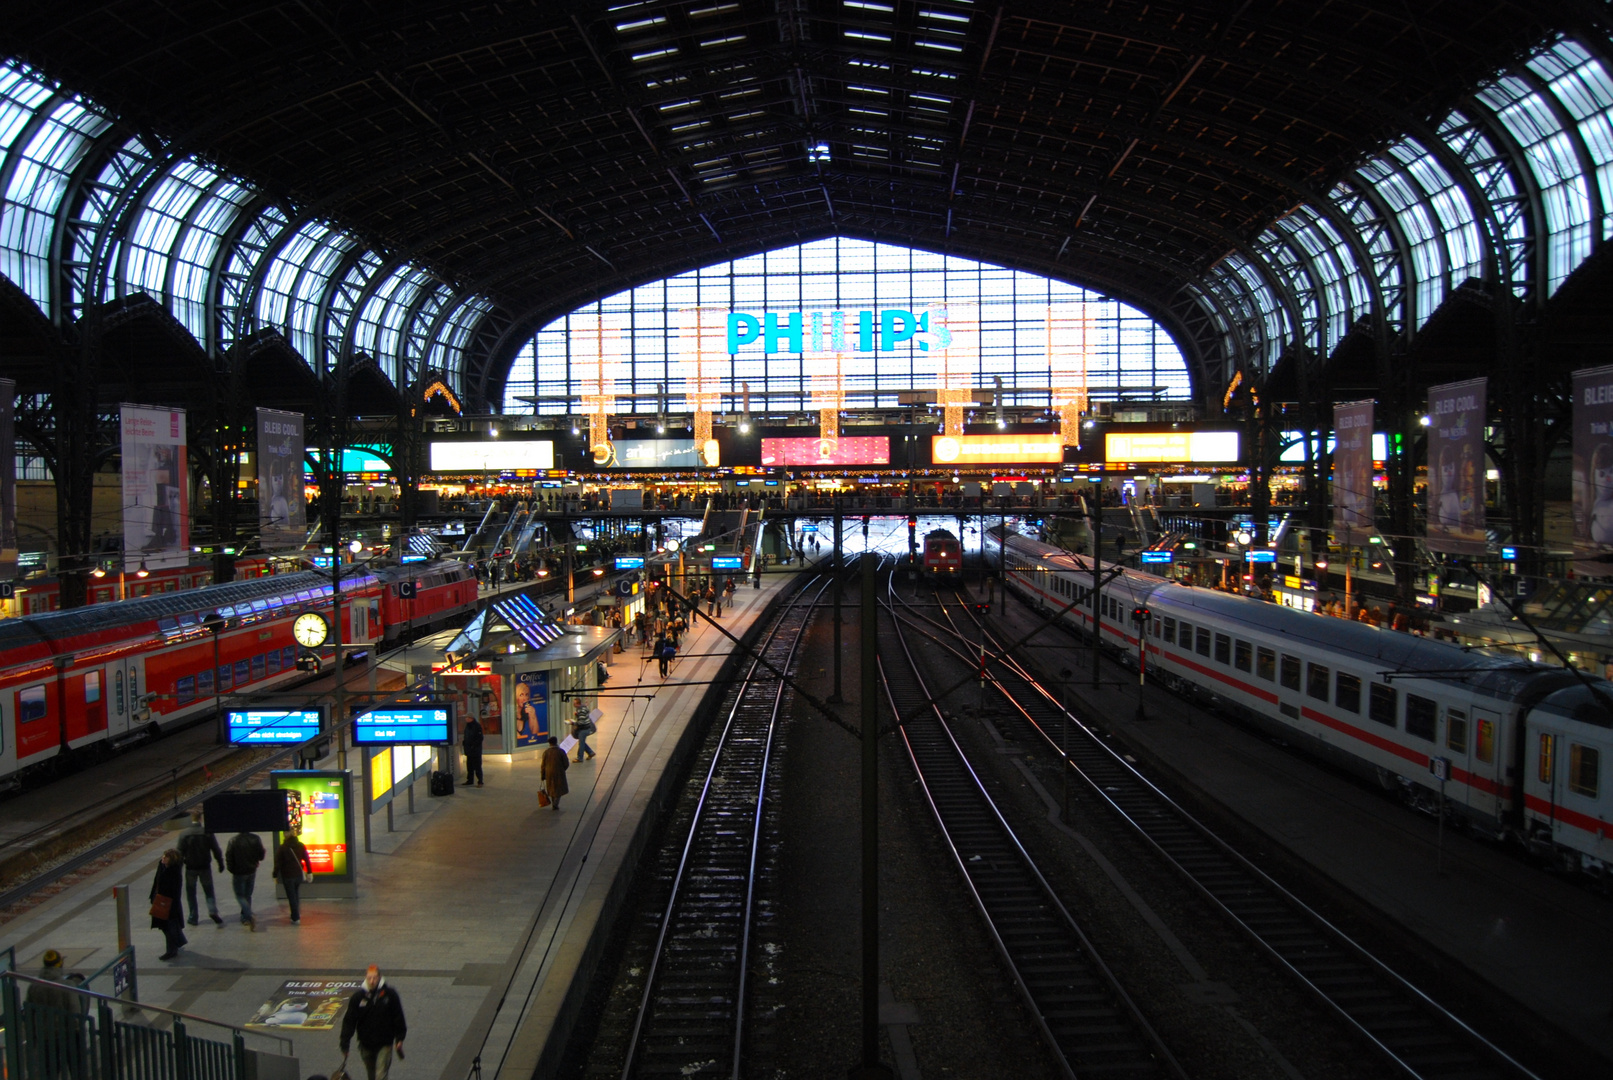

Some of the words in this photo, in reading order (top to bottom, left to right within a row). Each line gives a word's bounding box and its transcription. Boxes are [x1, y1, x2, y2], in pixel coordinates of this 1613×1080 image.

[727, 309, 953, 354] PHILIPS
[1435, 398, 1455, 414] BLEIB
[1456, 395, 1478, 412] COOL.
[264, 421, 282, 434] BLEIB
[282, 423, 299, 436] COOL.
[1339, 416, 1353, 429] BLEIB
[2, 584, 11, 596] D
[401, 582, 410, 595] C
[620, 580, 630, 594] C
[1517, 581, 1527, 596] E
[230, 713, 242, 723] 7a
[434, 710, 447, 721] 8a
